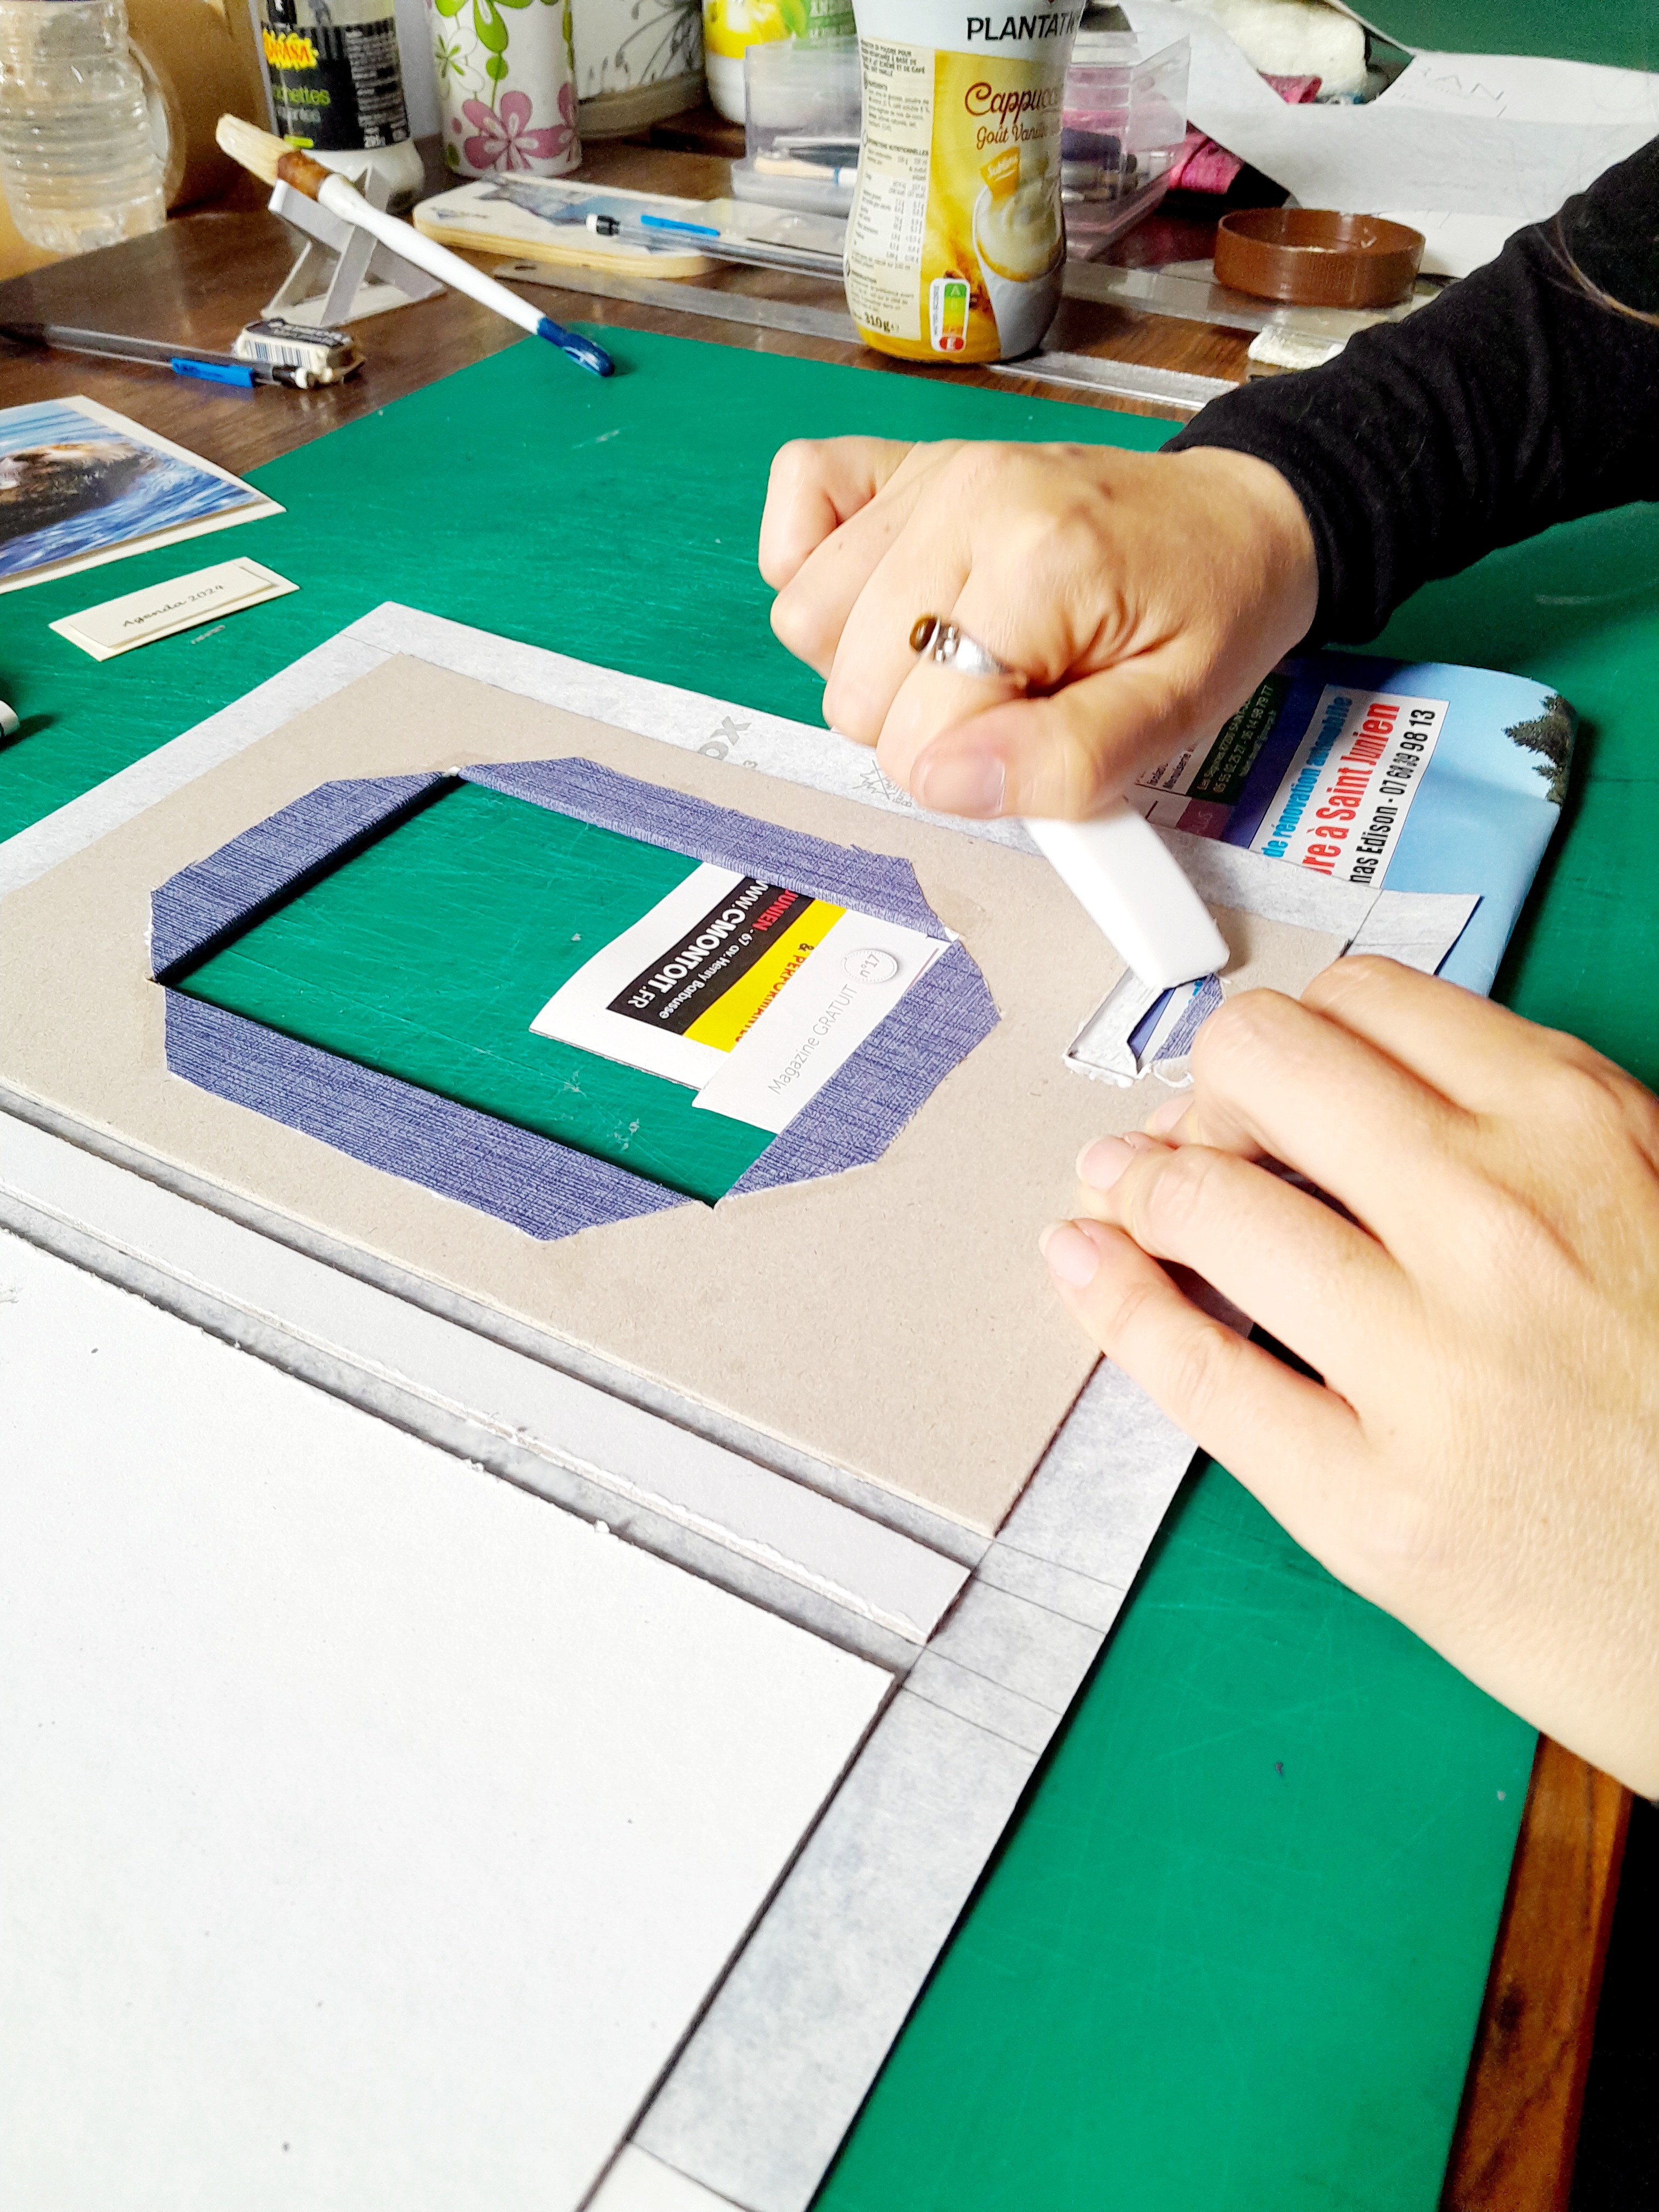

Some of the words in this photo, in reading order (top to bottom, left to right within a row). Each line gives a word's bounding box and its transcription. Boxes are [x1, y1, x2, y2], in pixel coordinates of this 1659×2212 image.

[976, 125, 1008, 151] Goût
[123, 600, 187, 627] Agenda
[188, 584, 224, 602] 2024
[1340, 703, 1400, 766] Junien
[1409, 709, 1436, 727] 13
[1399, 731, 1428, 752] 98
[1271, 768, 1321, 838] rénovation
[1315, 767, 1373, 821] Saint
[1379, 779, 1408, 796] 07
[1261, 840, 1288, 858] de
[1306, 826, 1350, 840] à
[1355, 806, 1398, 854] Edison
[751, 889, 800, 932] JUNIEN
[738, 933, 753, 947] 67
[659, 979, 706, 1019] Barbusse
[767, 1036, 820, 1095] Magazine
[812, 983, 857, 1036] GRATUIT
